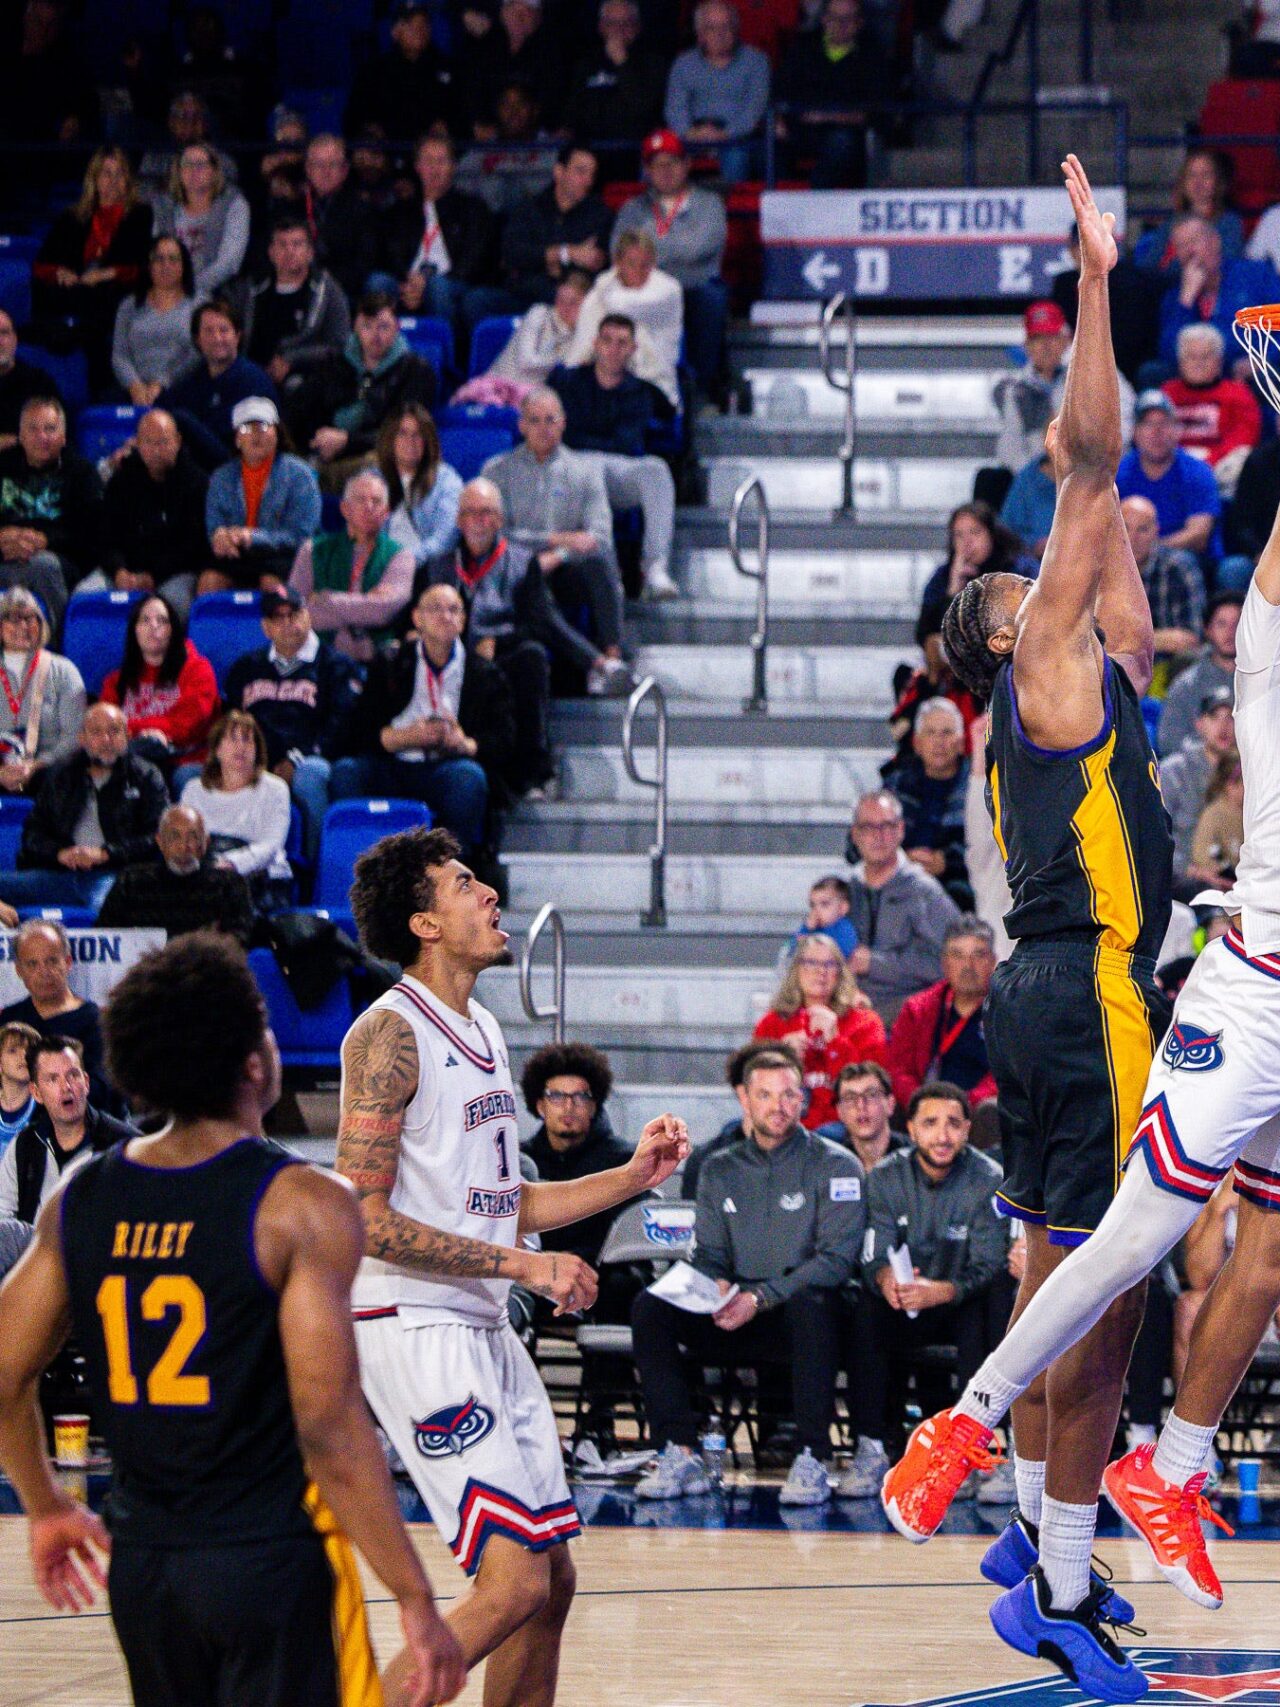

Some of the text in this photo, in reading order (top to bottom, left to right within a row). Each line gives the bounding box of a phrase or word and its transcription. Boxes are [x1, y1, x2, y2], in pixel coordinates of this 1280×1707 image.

[859, 199, 1026, 232] SECTION
[854, 245, 1033, 295] D E
[496, 1129, 509, 1180] 1
[111, 1221, 194, 1259] RILEY
[96, 1275, 211, 1406] 12
